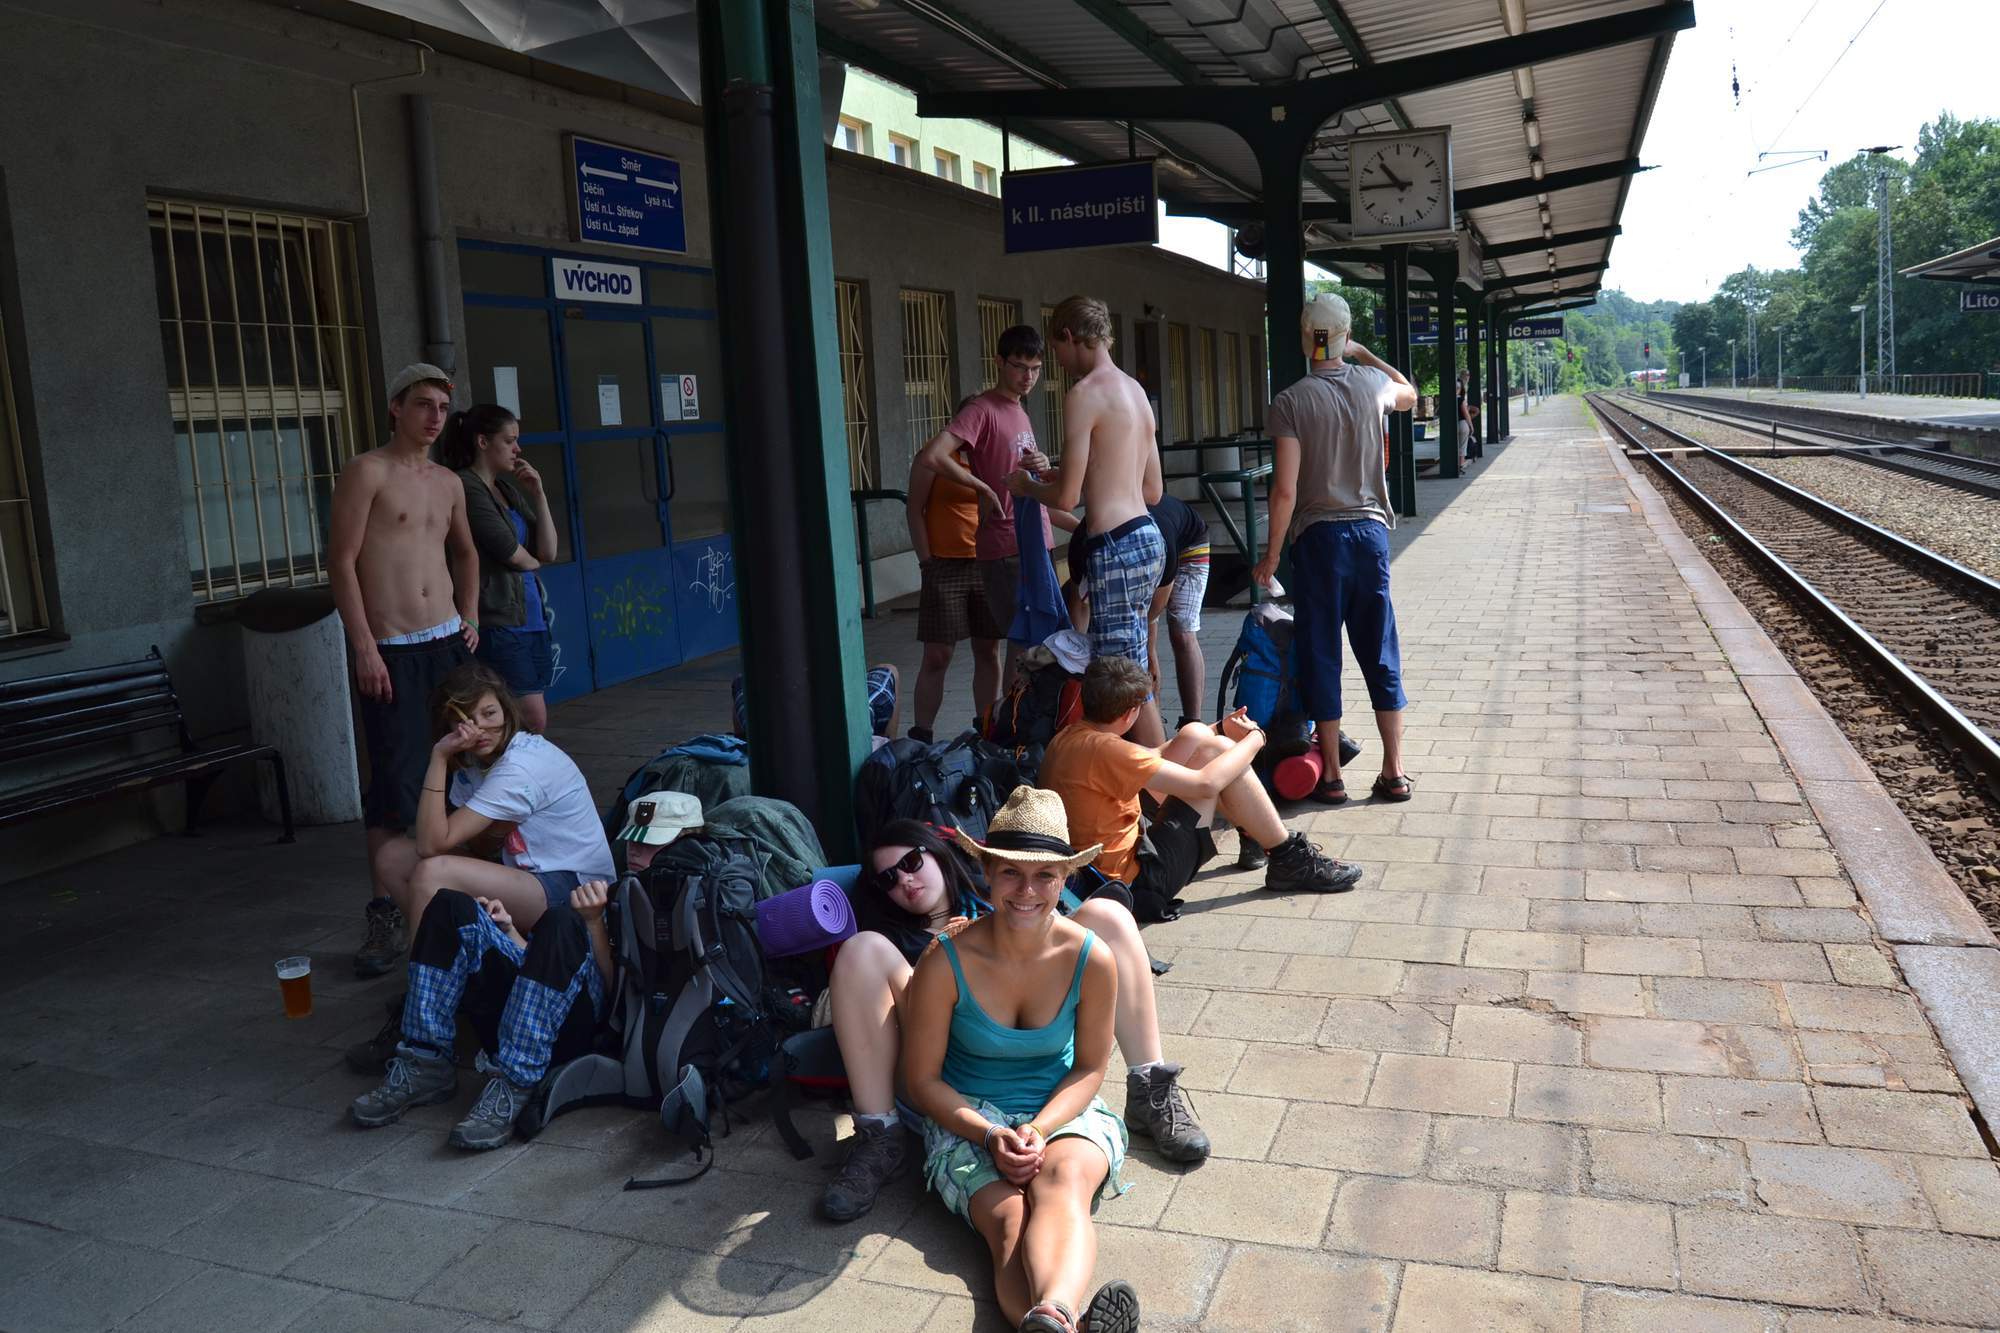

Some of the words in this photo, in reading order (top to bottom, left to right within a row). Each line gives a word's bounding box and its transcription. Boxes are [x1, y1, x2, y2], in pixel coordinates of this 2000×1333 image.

[621, 157, 642, 172] Směr
[616, 205, 644, 220] Střekov
[1012, 208, 1023, 224] k
[1051, 195, 1145, 221] nástupišti
[618, 223, 639, 237] západ
[562, 263, 633, 296] VÝCHOD
